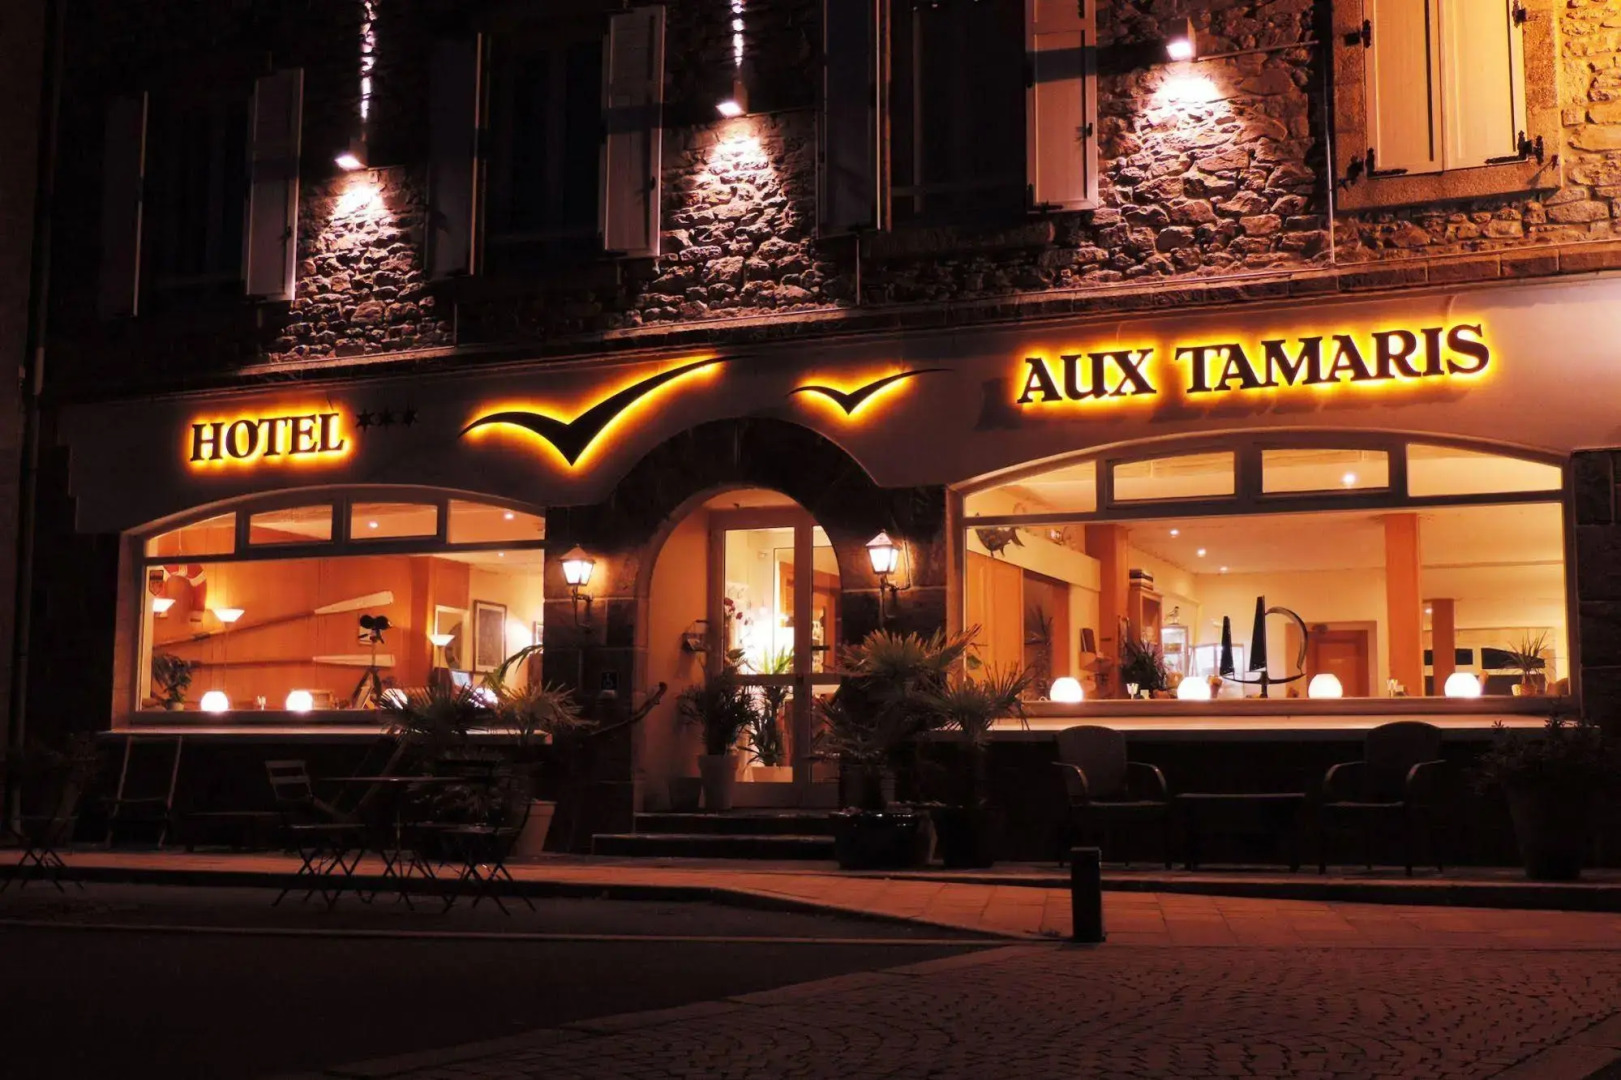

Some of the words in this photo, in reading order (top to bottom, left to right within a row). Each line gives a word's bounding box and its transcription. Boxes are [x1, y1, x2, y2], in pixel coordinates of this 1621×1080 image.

[1017, 348, 1157, 403] AUX
[1175, 324, 1489, 393] TAMARIS
[190, 413, 344, 461] HOTEL
